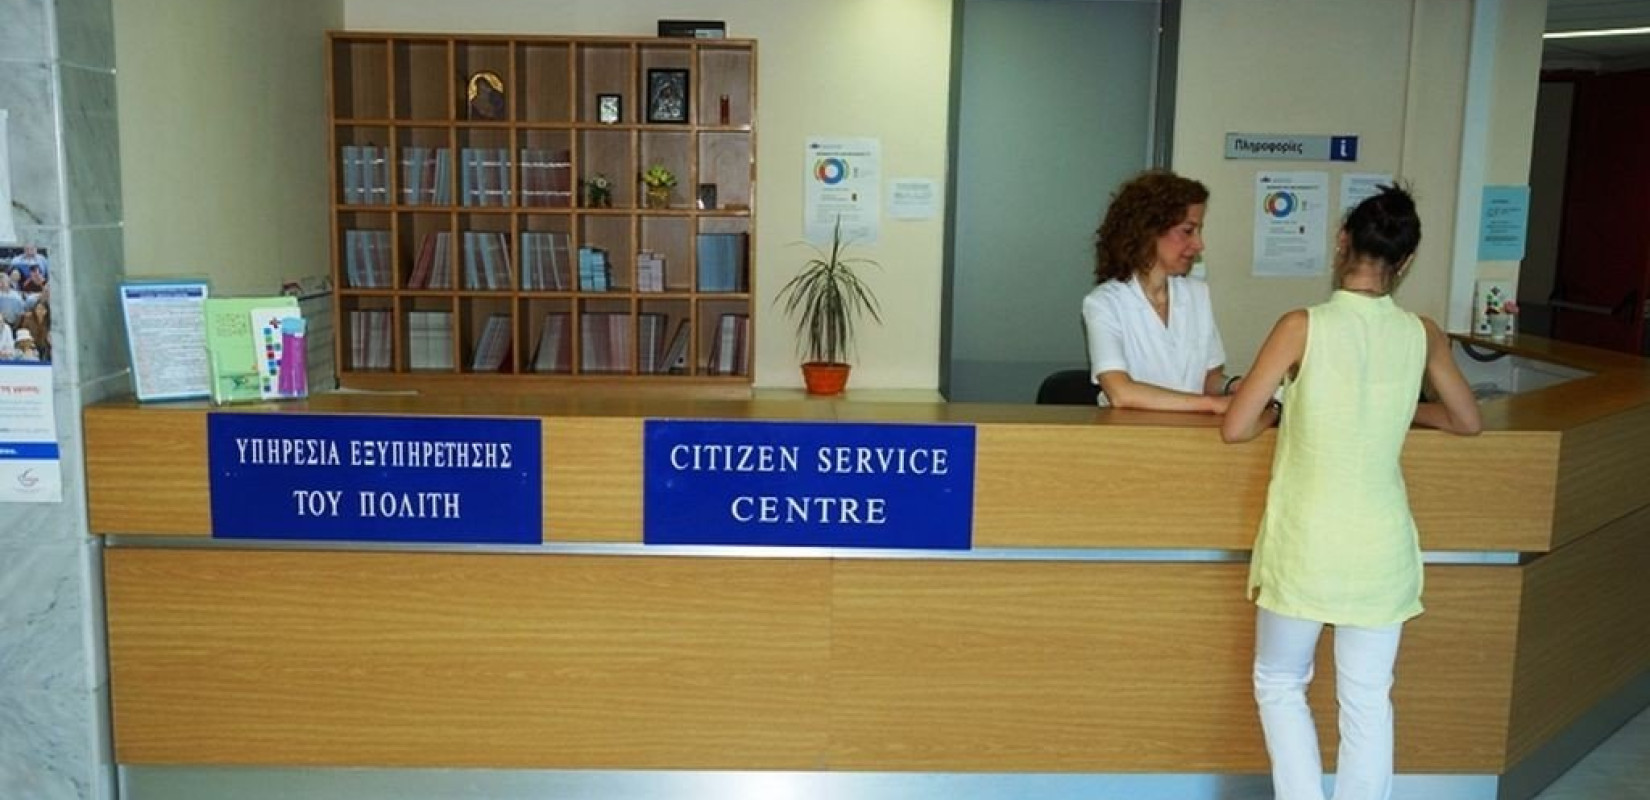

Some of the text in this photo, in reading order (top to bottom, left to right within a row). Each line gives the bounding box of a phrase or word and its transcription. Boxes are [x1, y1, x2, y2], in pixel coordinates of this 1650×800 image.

[1234, 138, 1303, 155] Πληροφορίες
[236, 438, 512, 469] ΥΠΗΡΕΣΙΑ ΕΞΥΠΗΡΕΤΗΣΗΣ
[670, 444, 949, 474] CITIZEN SERVICE
[293, 490, 460, 519] ΤΟΥ ΠΟΛΙΤΗ
[731, 496, 887, 524] CENTRE
